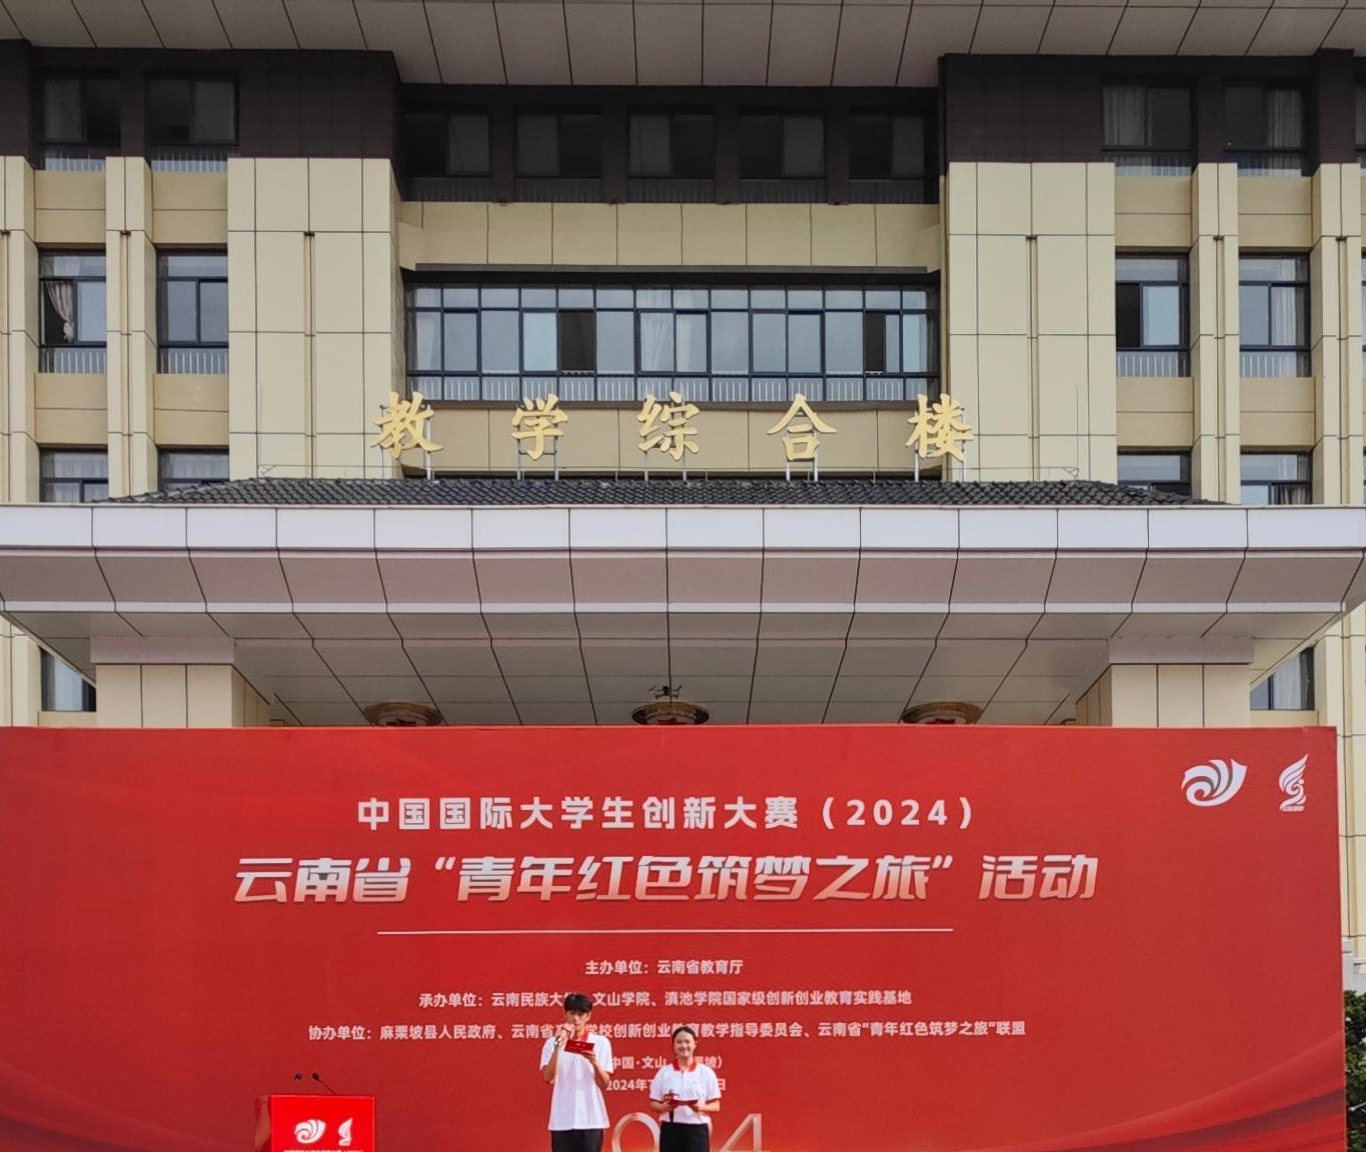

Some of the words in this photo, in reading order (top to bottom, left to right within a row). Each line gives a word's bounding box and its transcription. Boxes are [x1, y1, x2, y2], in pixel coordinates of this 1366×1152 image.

[371, 391, 975, 463] 教学综合楼
[358, 796, 974, 832] 中国国际大学生创新大赛（2024）
[585, 959, 744, 976] 主办单位：云南省教育厅
[418, 990, 912, 1008] 承办单位：云南民族大文山学院、滇池学院国家级创新创业教育实践基地
